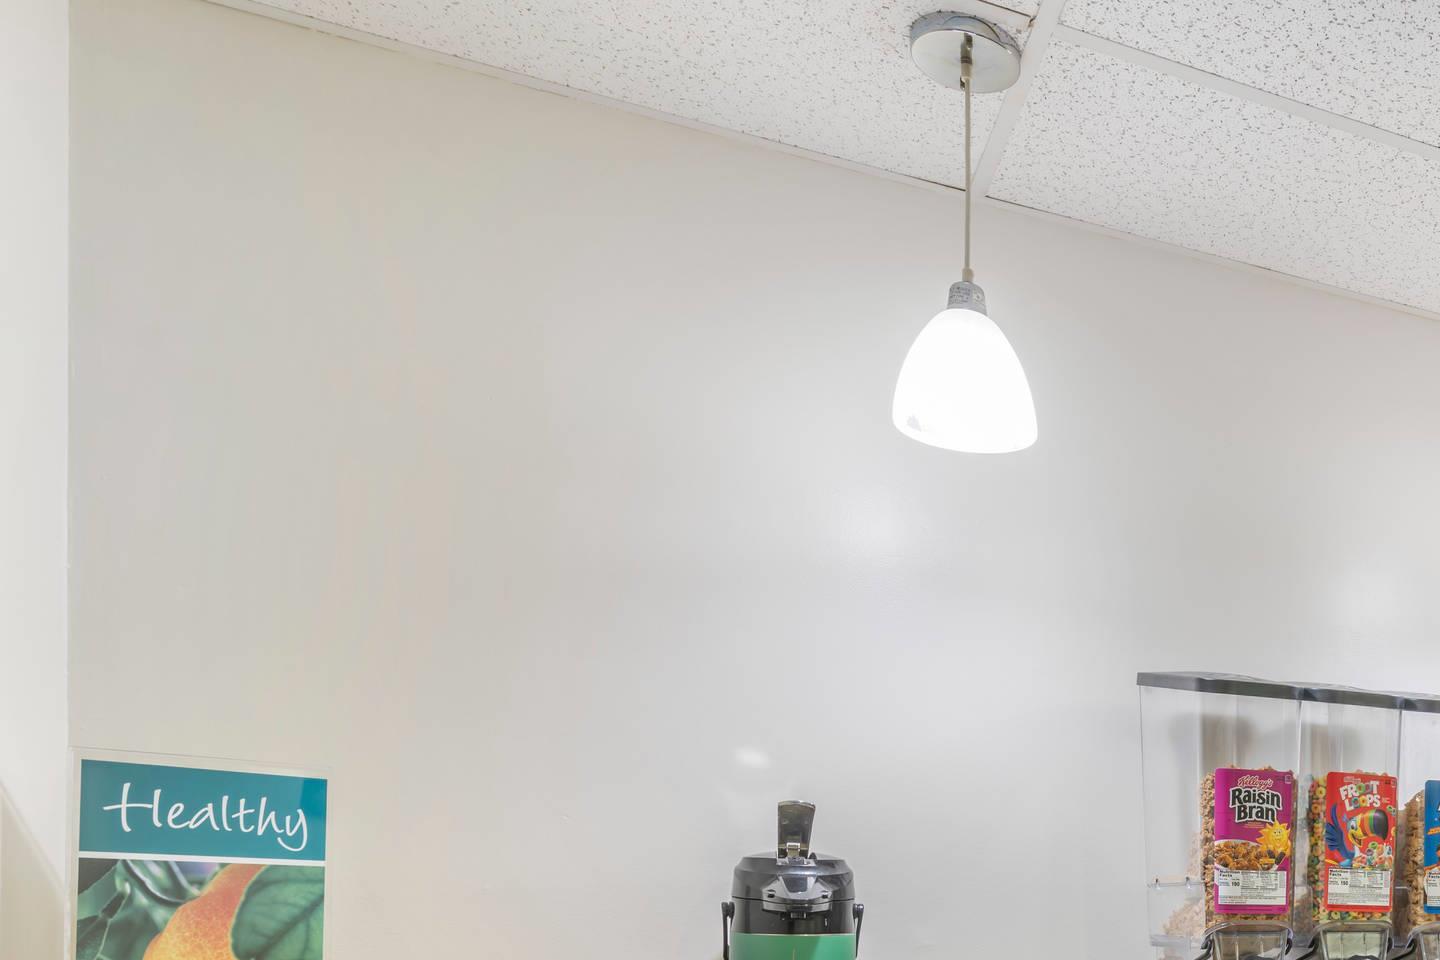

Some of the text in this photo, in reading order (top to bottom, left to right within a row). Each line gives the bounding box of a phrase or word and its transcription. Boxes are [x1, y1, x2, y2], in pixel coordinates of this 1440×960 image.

[1237, 775, 1274, 790] Kellogg's
[1229, 787, 1282, 810] Raisin
[1344, 794, 1380, 811] LOOPS
[103, 782, 308, 852] Healthy
[1235, 805, 1277, 823] Bran
